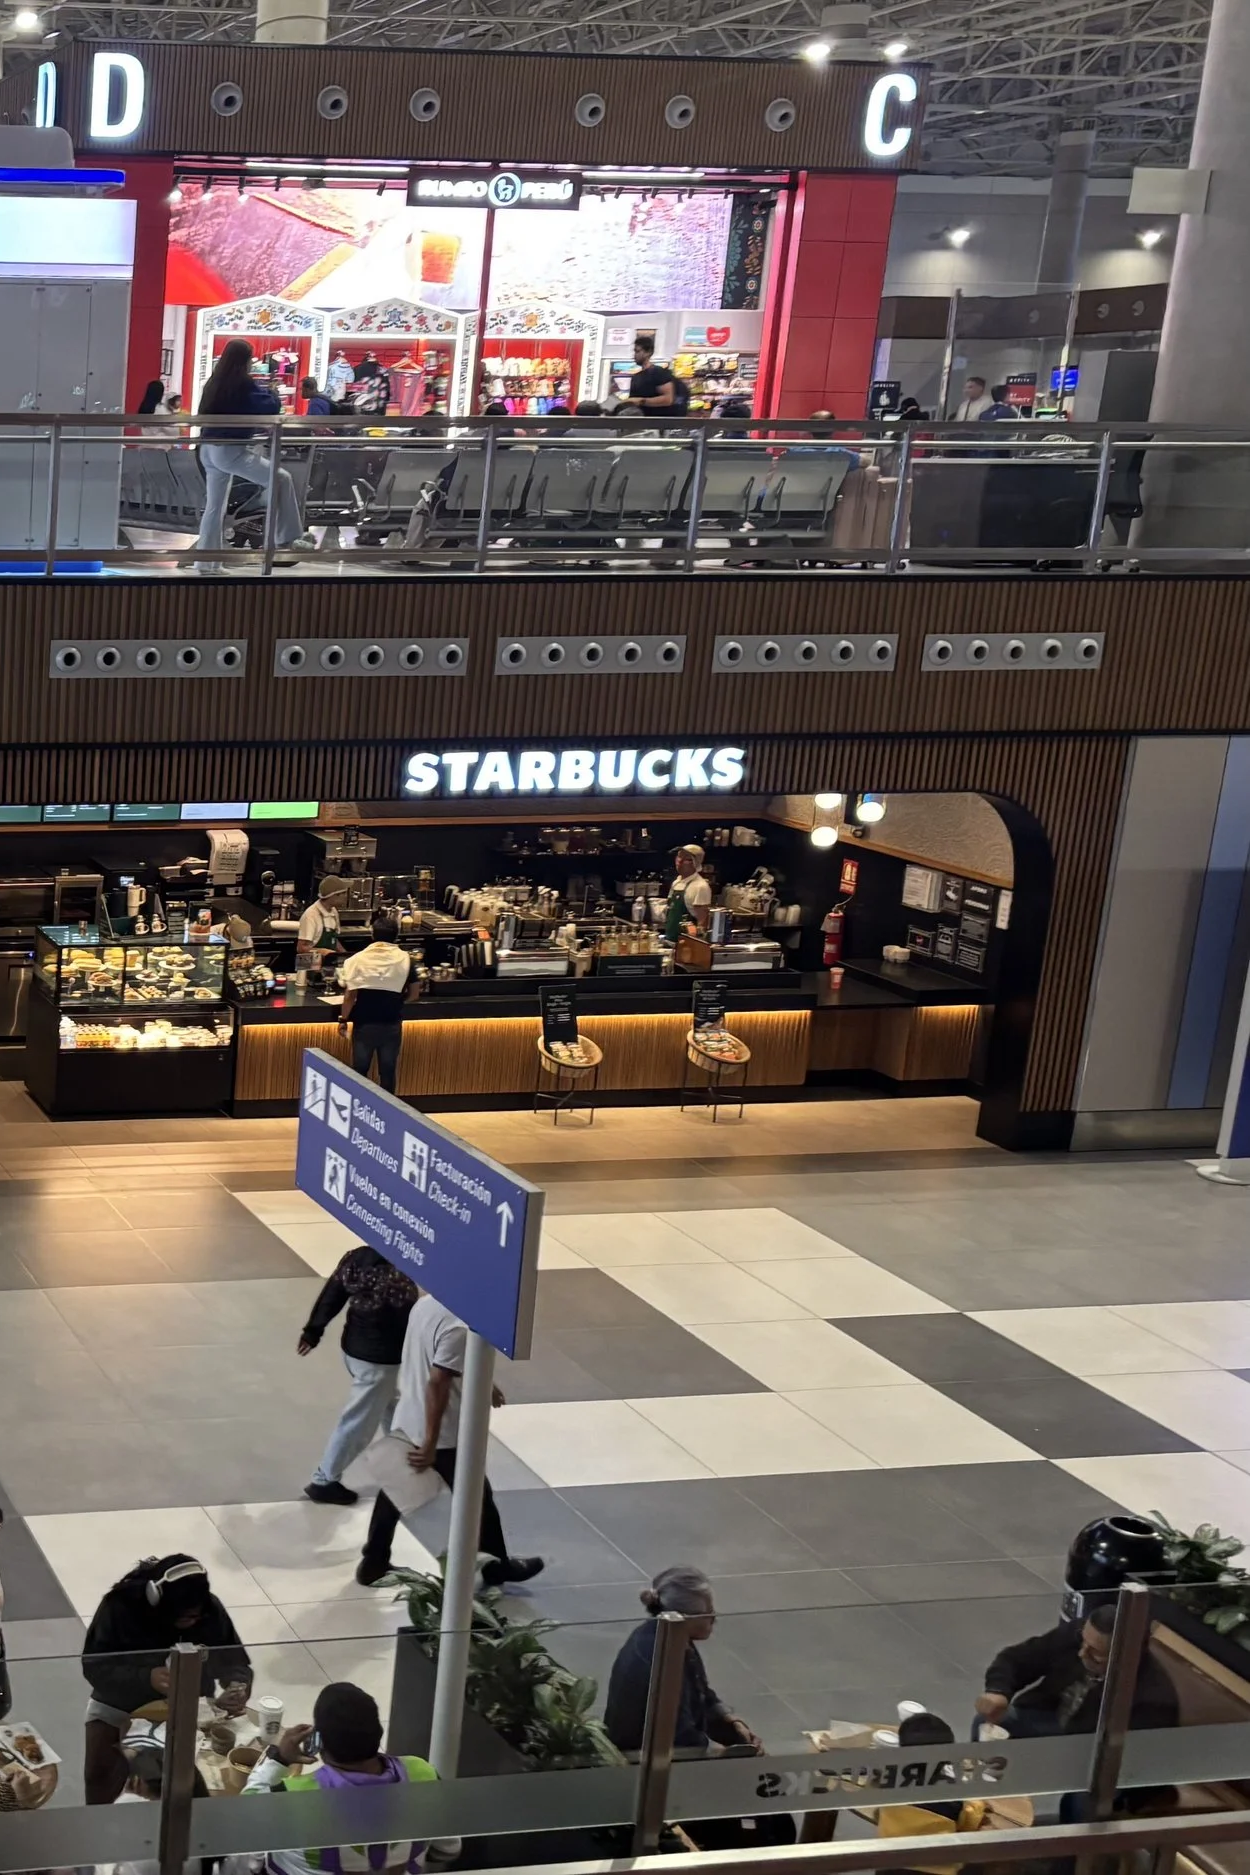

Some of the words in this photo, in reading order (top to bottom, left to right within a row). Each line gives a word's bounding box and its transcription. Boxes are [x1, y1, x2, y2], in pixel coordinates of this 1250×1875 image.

[90, 52, 145, 138] D
[865, 73, 917, 156] C
[521, 179, 574, 200] PERÚ
[404, 747, 745, 792] STARBUCKS
[353, 1098, 386, 1135] Salidas
[351, 1127, 399, 1173] Departures
[428, 1181, 472, 1224] Check-in
[430, 1149, 492, 1206] Facturación
[349, 1164, 378, 1200] Vuelos
[379, 1192, 392, 1211] en
[392, 1202, 435, 1243] conexión
[346, 1193, 393, 1245] Connecting
[393, 1230, 425, 1266] Flights
